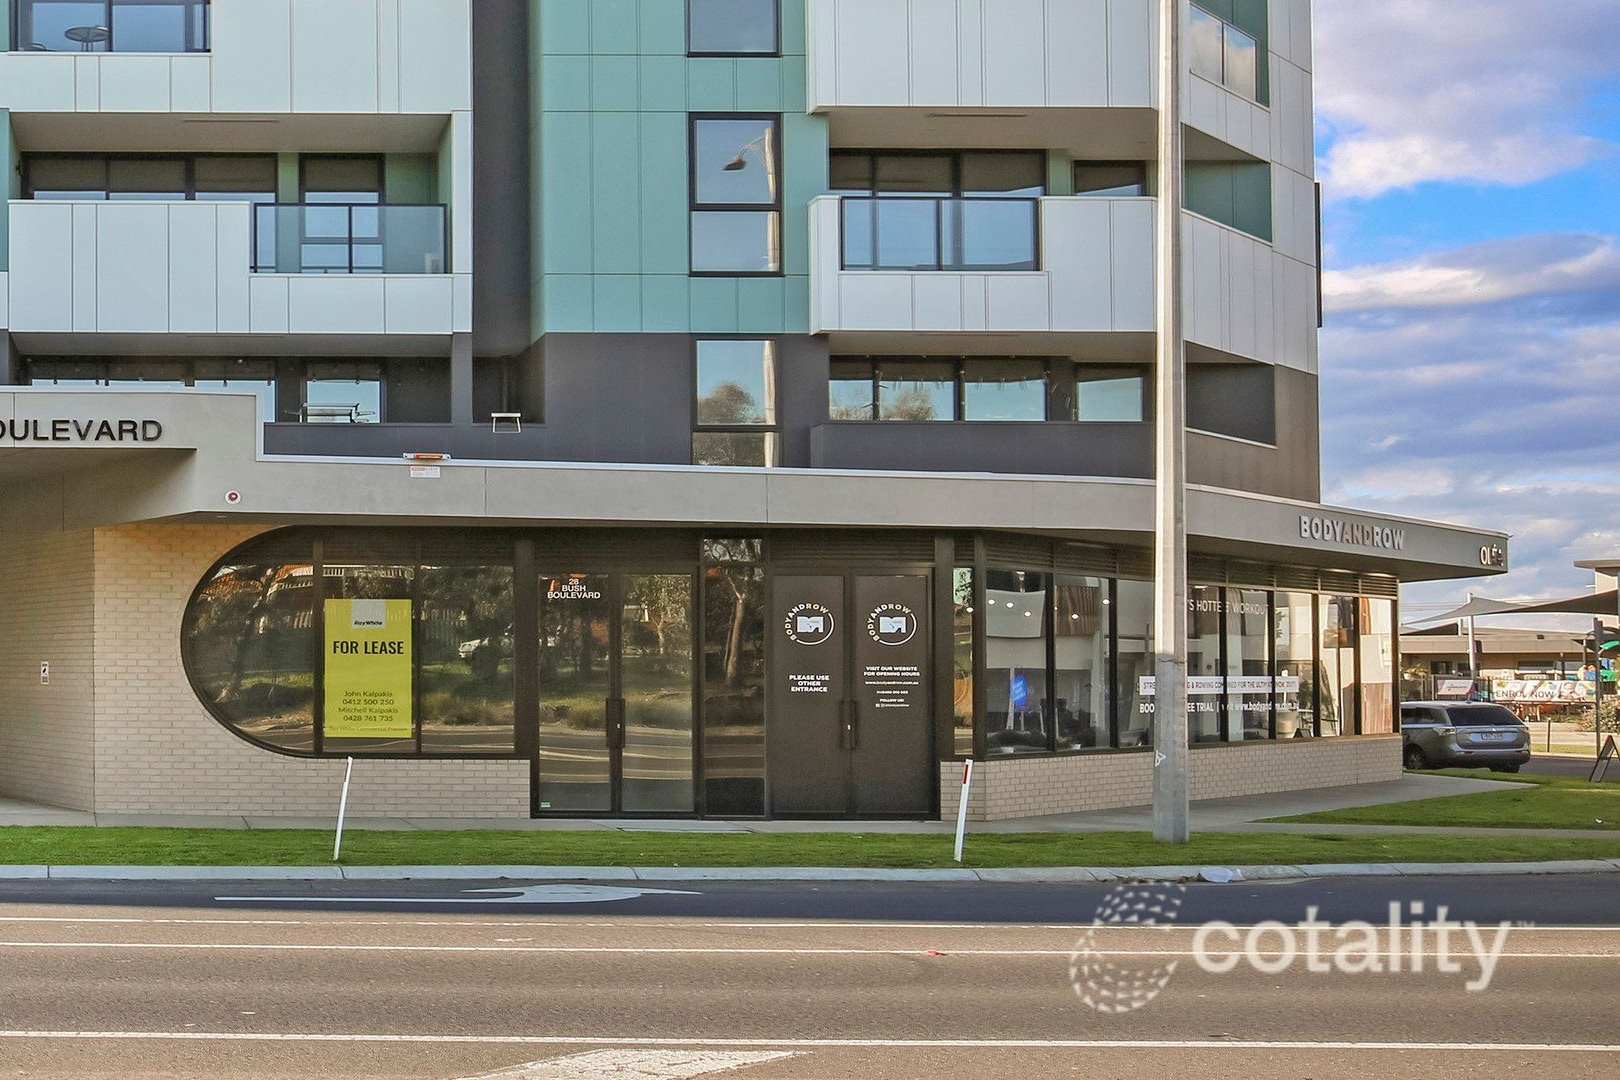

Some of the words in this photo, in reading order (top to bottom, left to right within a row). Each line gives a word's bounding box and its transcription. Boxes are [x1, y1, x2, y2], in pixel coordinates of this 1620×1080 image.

[1299, 515, 1405, 550] BODYANDROW
[785, 603, 829, 641] BODYANDROW
[867, 603, 912, 641] BODYANDROW
[333, 641, 359, 654] FOR
[364, 641, 404, 654] LEASE
[1530, 690, 1555, 698] NOW
[1140, 703, 1155, 713] BOO
[1196, 702, 1214, 712] TRIAL
